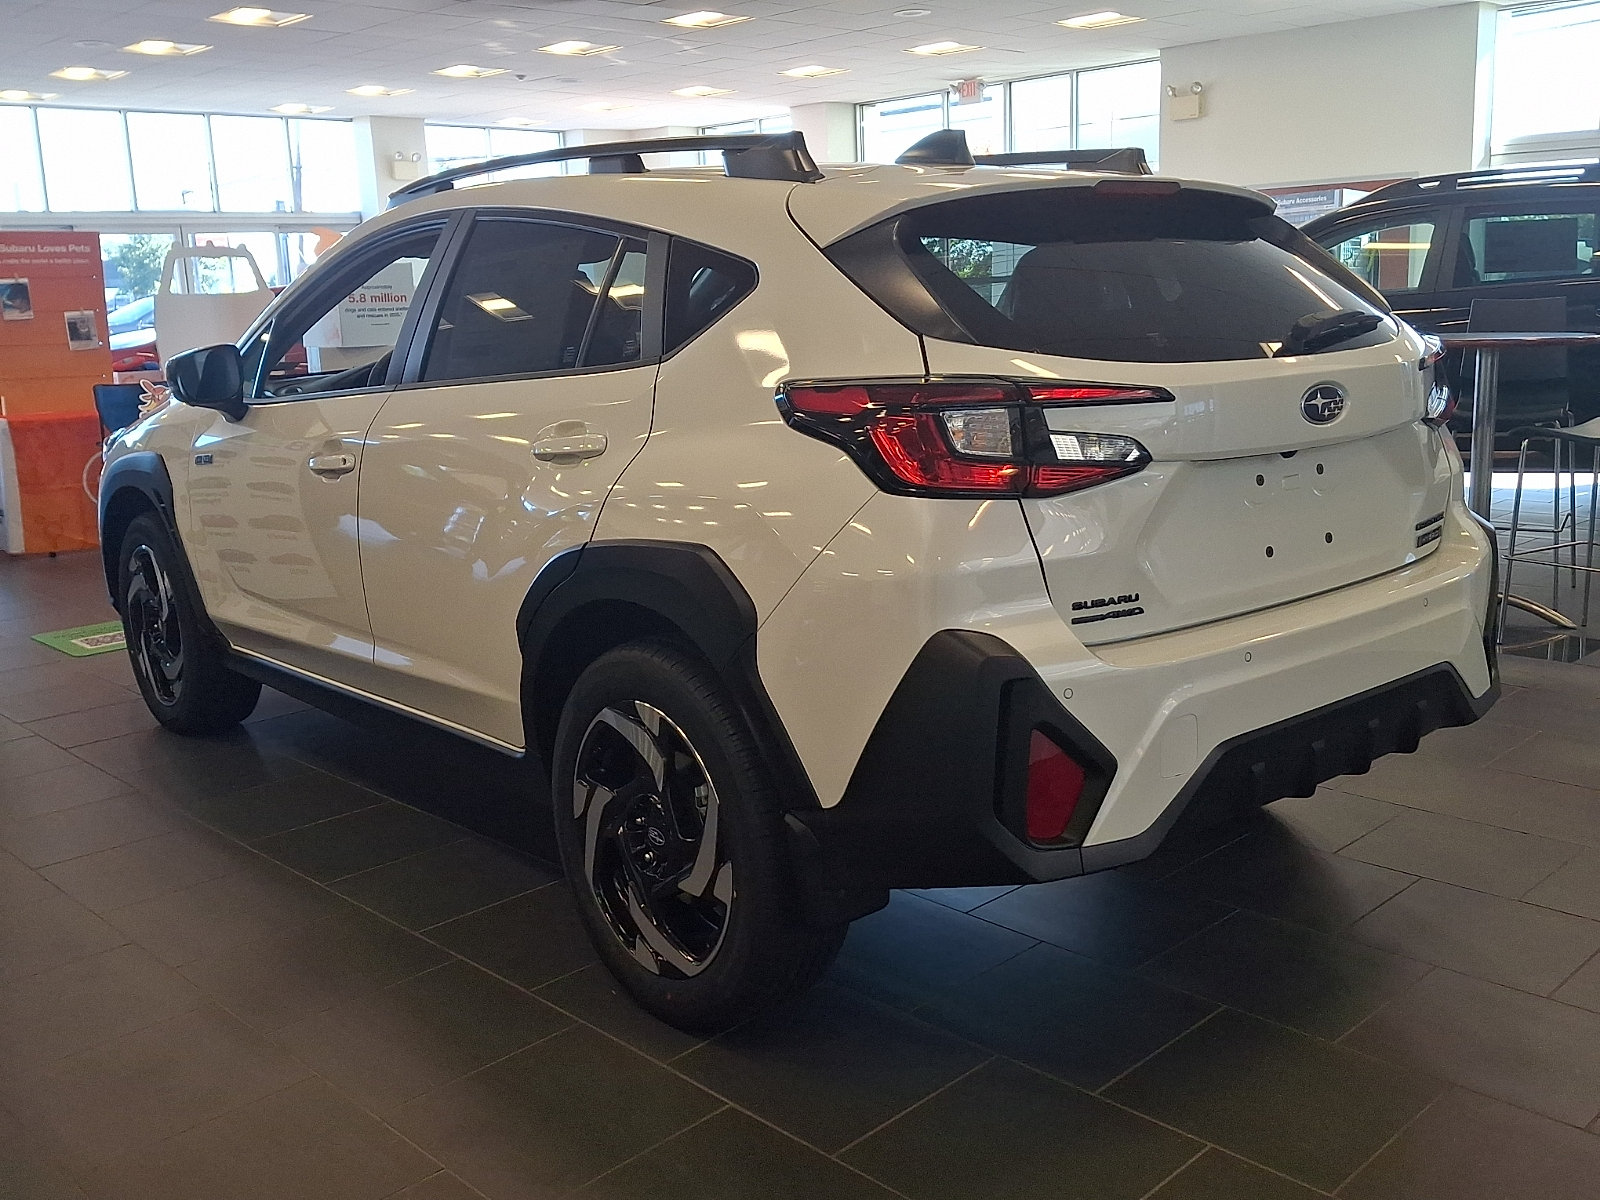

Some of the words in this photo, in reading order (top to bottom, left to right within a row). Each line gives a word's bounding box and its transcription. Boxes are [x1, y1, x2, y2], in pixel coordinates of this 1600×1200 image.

[961, 82, 977, 97] EXIT
[1296, 195, 1328, 203] Accessories
[0, 243, 35, 253] Subaru
[37, 243, 67, 253] Loves
[68, 243, 91, 253] Pets
[348, 293, 367, 303] 5.8
[370, 292, 407, 303] million
[1071, 593, 1140, 611] SUBARU
